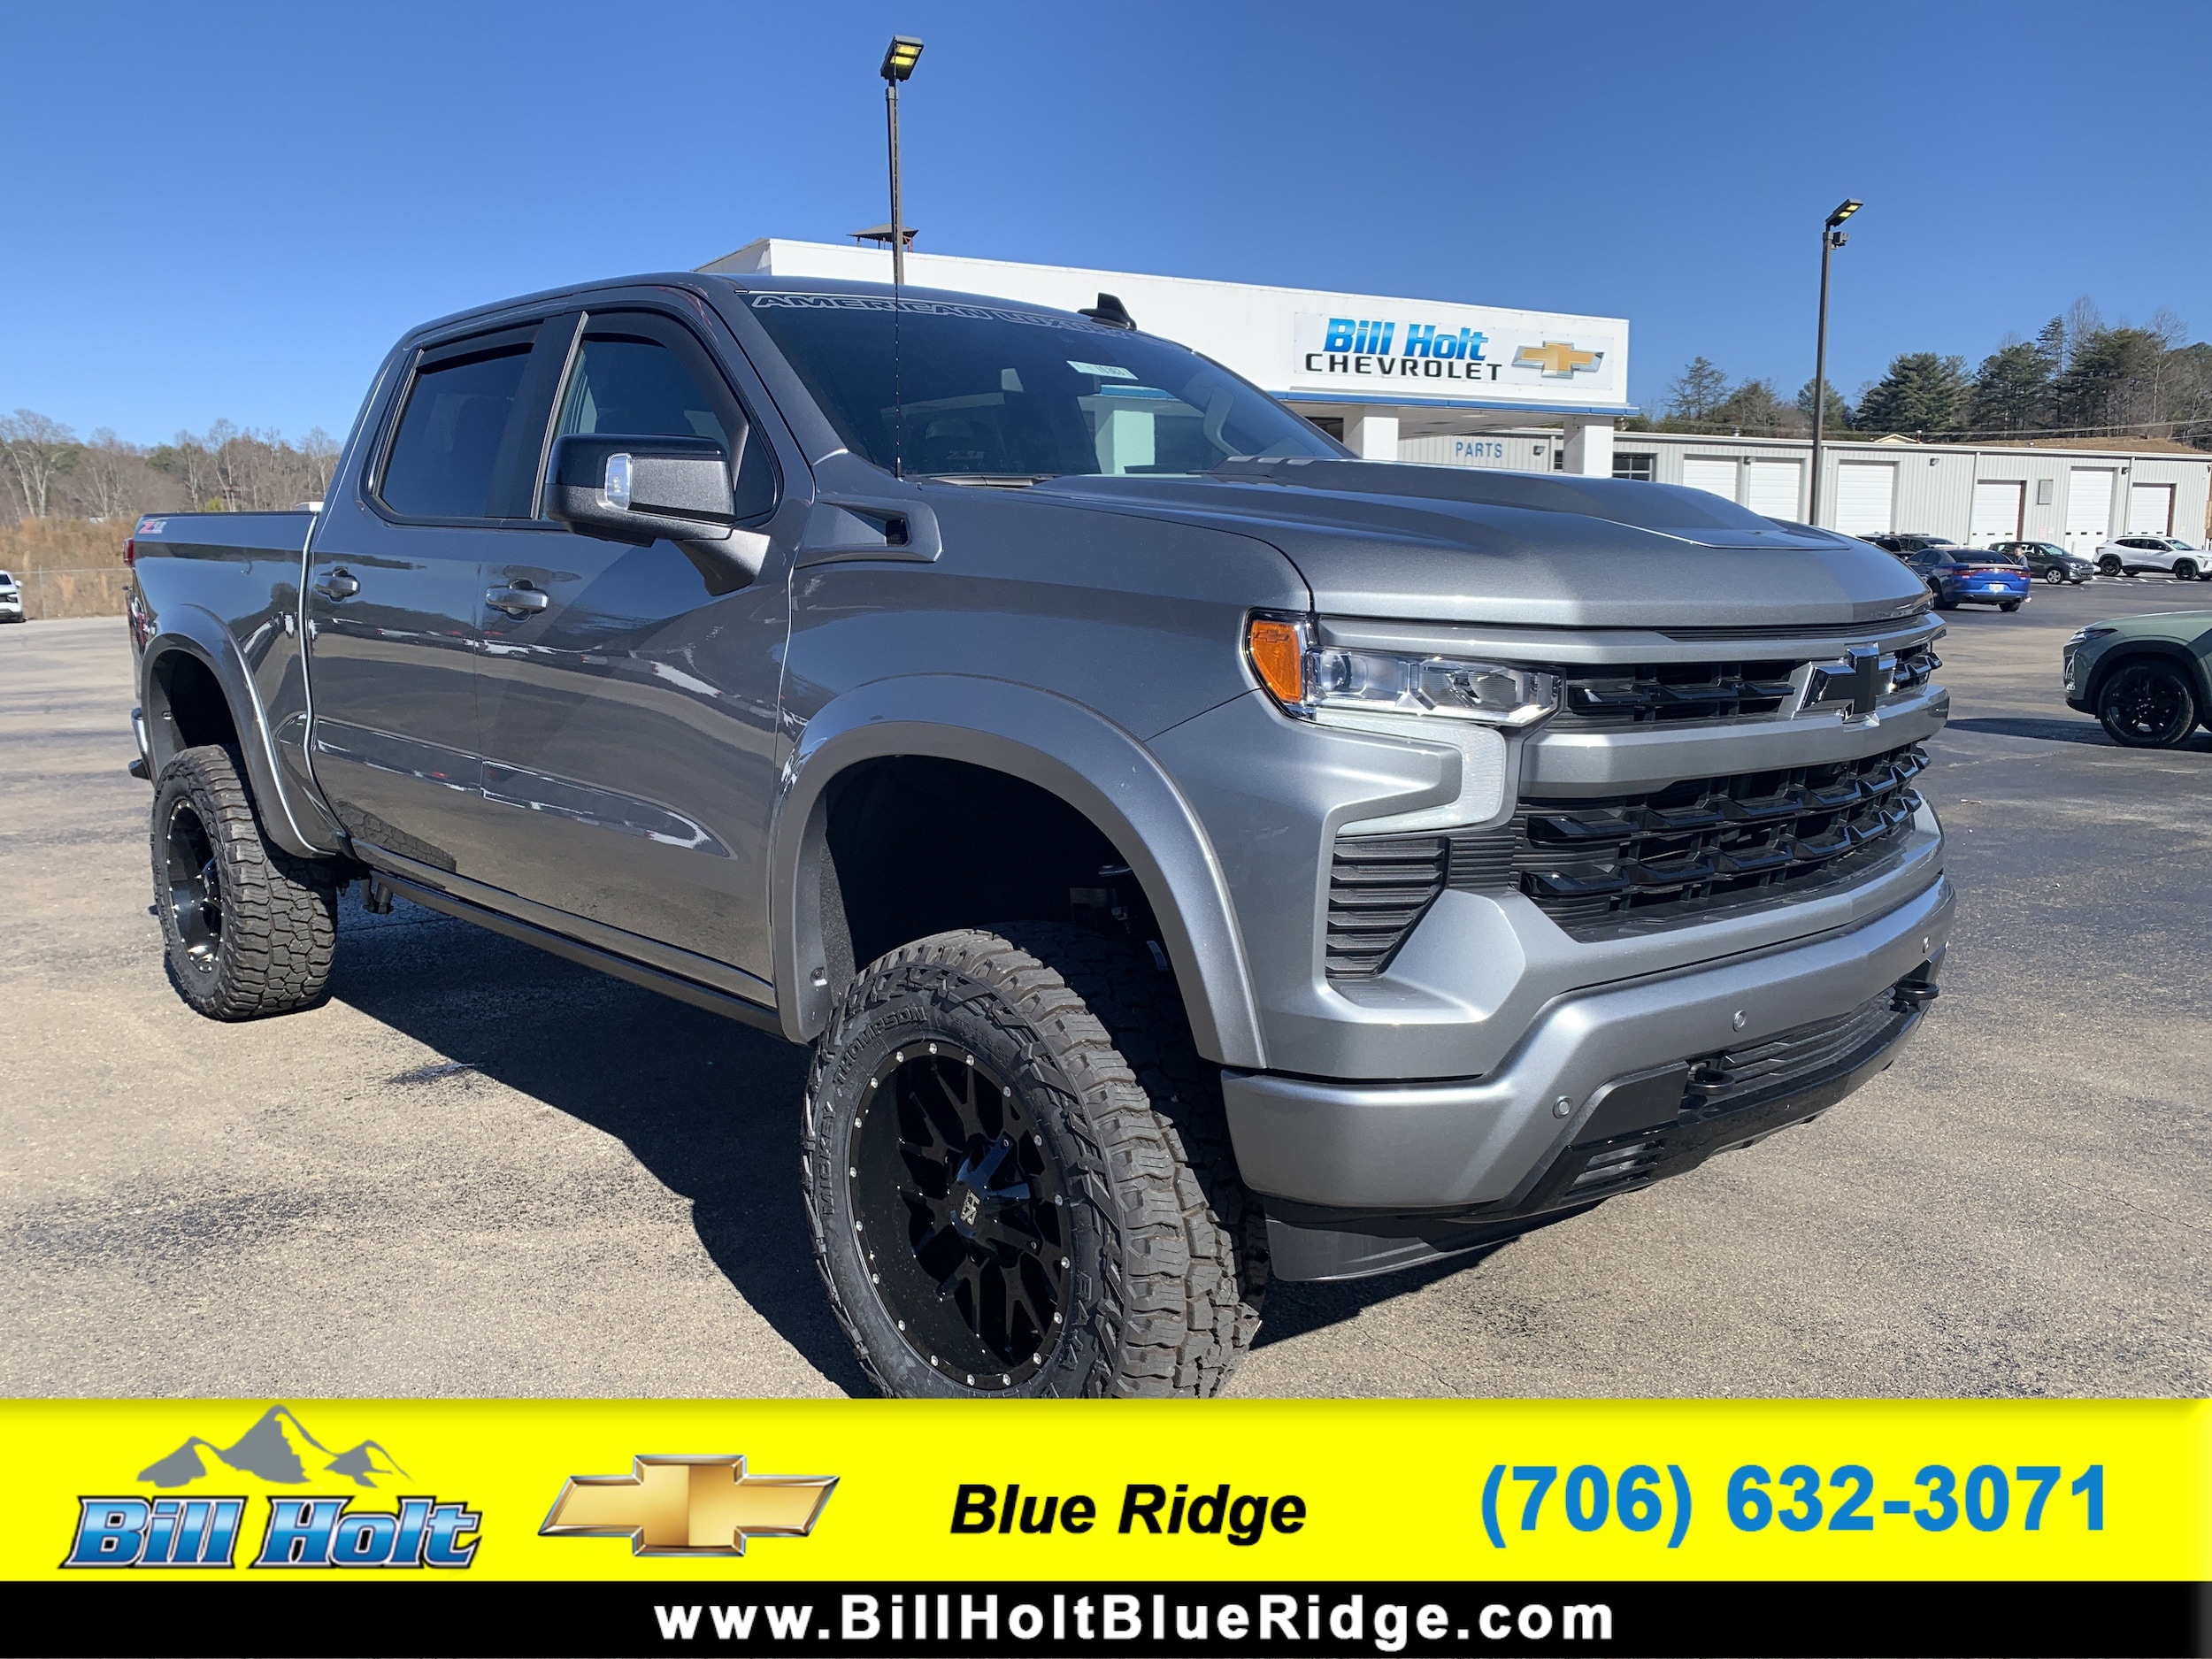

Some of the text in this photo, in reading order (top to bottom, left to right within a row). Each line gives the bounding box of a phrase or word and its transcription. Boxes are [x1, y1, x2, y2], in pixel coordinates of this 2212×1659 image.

[751, 295, 994, 319] AMERICAN
[1324, 318, 1488, 361] Bill Holt
[1305, 352, 1502, 380] CHEVROLET
[1455, 442, 1502, 458] PARTS
[820, 1100, 836, 1216] MICKEY
[833, 1005, 928, 1085] THOMPSON
